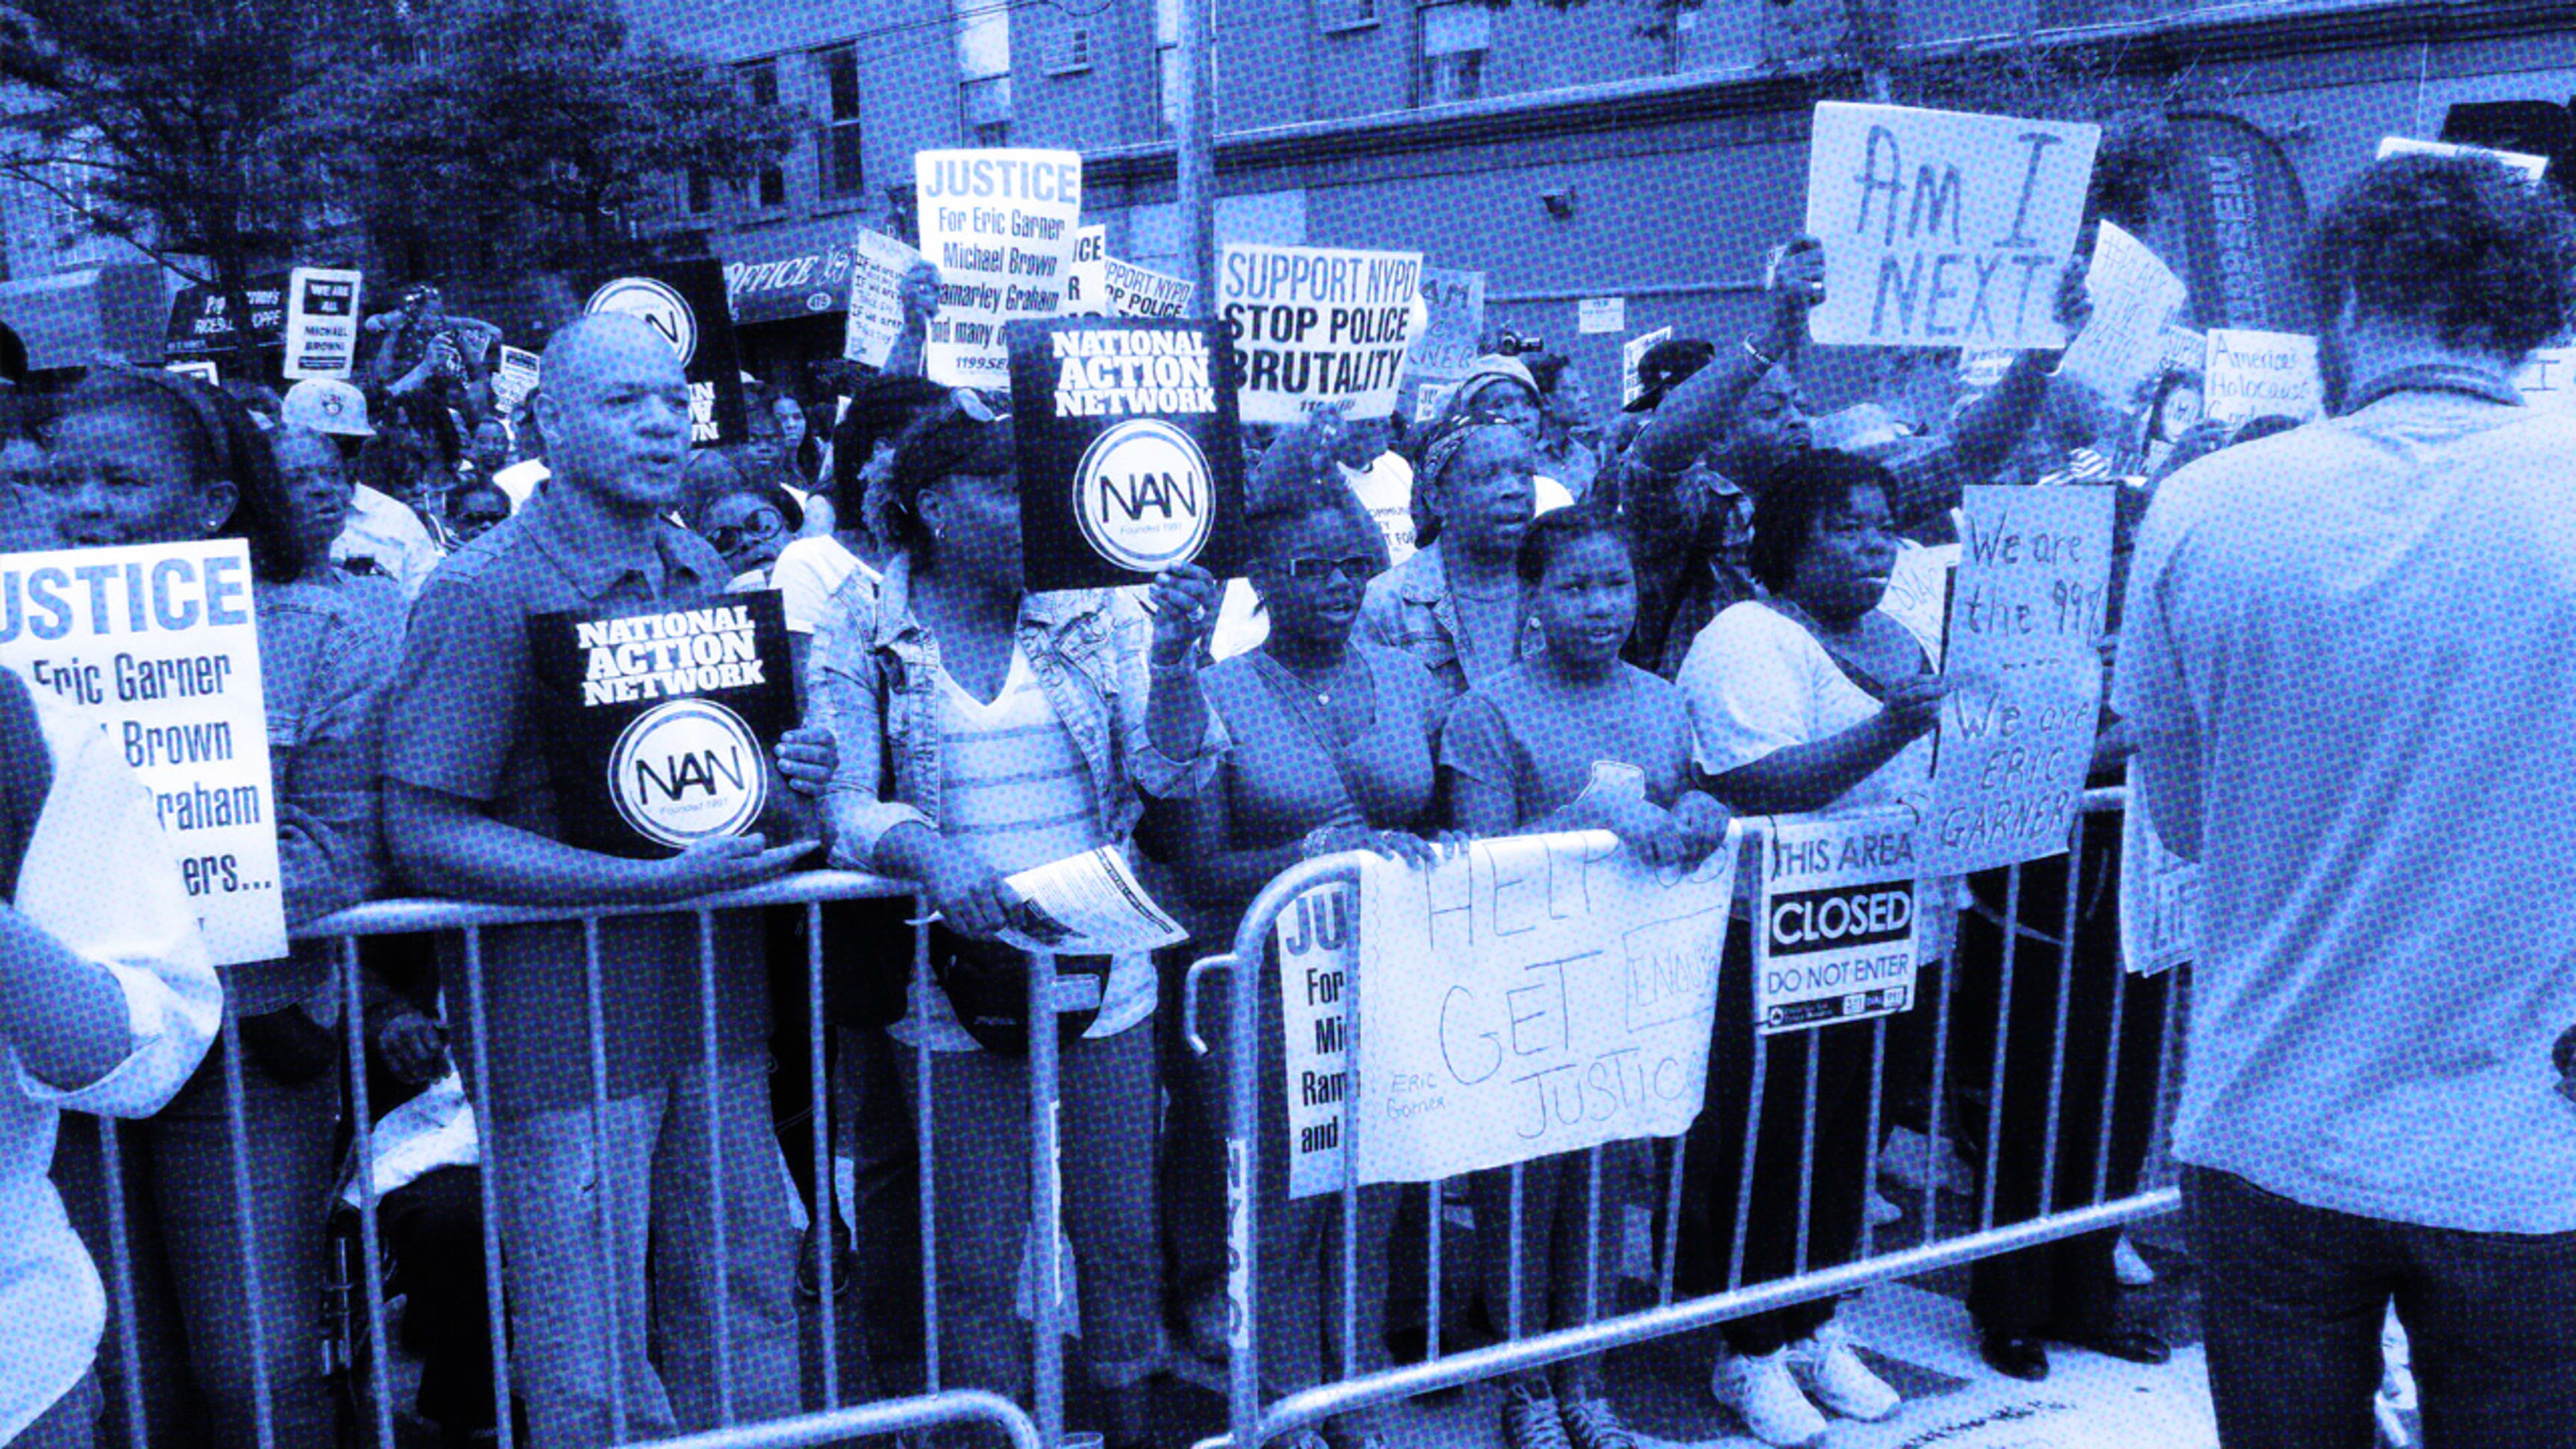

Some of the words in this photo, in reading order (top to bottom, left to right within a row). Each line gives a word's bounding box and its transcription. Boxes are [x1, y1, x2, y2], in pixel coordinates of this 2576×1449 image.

[925, 160, 1077, 203] JUSTICE
[1992, 131, 2063, 248] I
[939, 207, 966, 233] For
[973, 207, 1005, 235] Eric
[1012, 209, 1065, 241] Garner
[943, 242, 1004, 272] Michael
[1009, 247, 1057, 276] Brown
[1106, 259, 1155, 295] PPORT
[1226, 252, 1362, 303] SUPPORT
[1367, 258, 1417, 303] NYPD
[938, 282, 1002, 314] amarley
[1006, 284, 1059, 311] Graham
[1870, 252, 2055, 340] NEXT
[955, 321, 994, 349] many
[1051, 330, 1210, 358] NATIONAL
[1224, 303, 1318, 343] STOP
[1331, 307, 1409, 344] POLICE
[956, 356, 1007, 370] 1199SE
[1058, 356, 1210, 389] ACTION
[1233, 348, 1404, 394] BRUTALITY
[1055, 388, 1217, 417] NETWORK
[1100, 470, 1197, 523] NAN
[1970, 511, 2020, 568] We
[2033, 533, 2082, 566] are
[576, 606, 756, 649] NATIONAL
[1966, 584, 2032, 637] the
[114, 652, 232, 702] Garner
[586, 630, 757, 680] ACTION
[582, 659, 765, 707] NETWORK
[1955, 688, 2022, 740] We
[2039, 702, 2090, 733] are
[123, 720, 233, 768] Brown
[636, 745, 745, 805] NAN
[1982, 746, 2063, 790] ERIC
[146, 782, 261, 833] raham
[1939, 790, 2070, 848] GARNER
[1774, 839, 1831, 877] THIS
[1838, 833, 1915, 871] AREA
[1424, 833, 1619, 950] HELP
[1772, 891, 1911, 945] CLOSED
[1768, 969, 1802, 994] DO
[1807, 961, 1850, 989] NOT
[1854, 953, 1909, 982] ENTER
[1440, 950, 1604, 1085] GET
[1301, 1116, 1338, 1154] and
